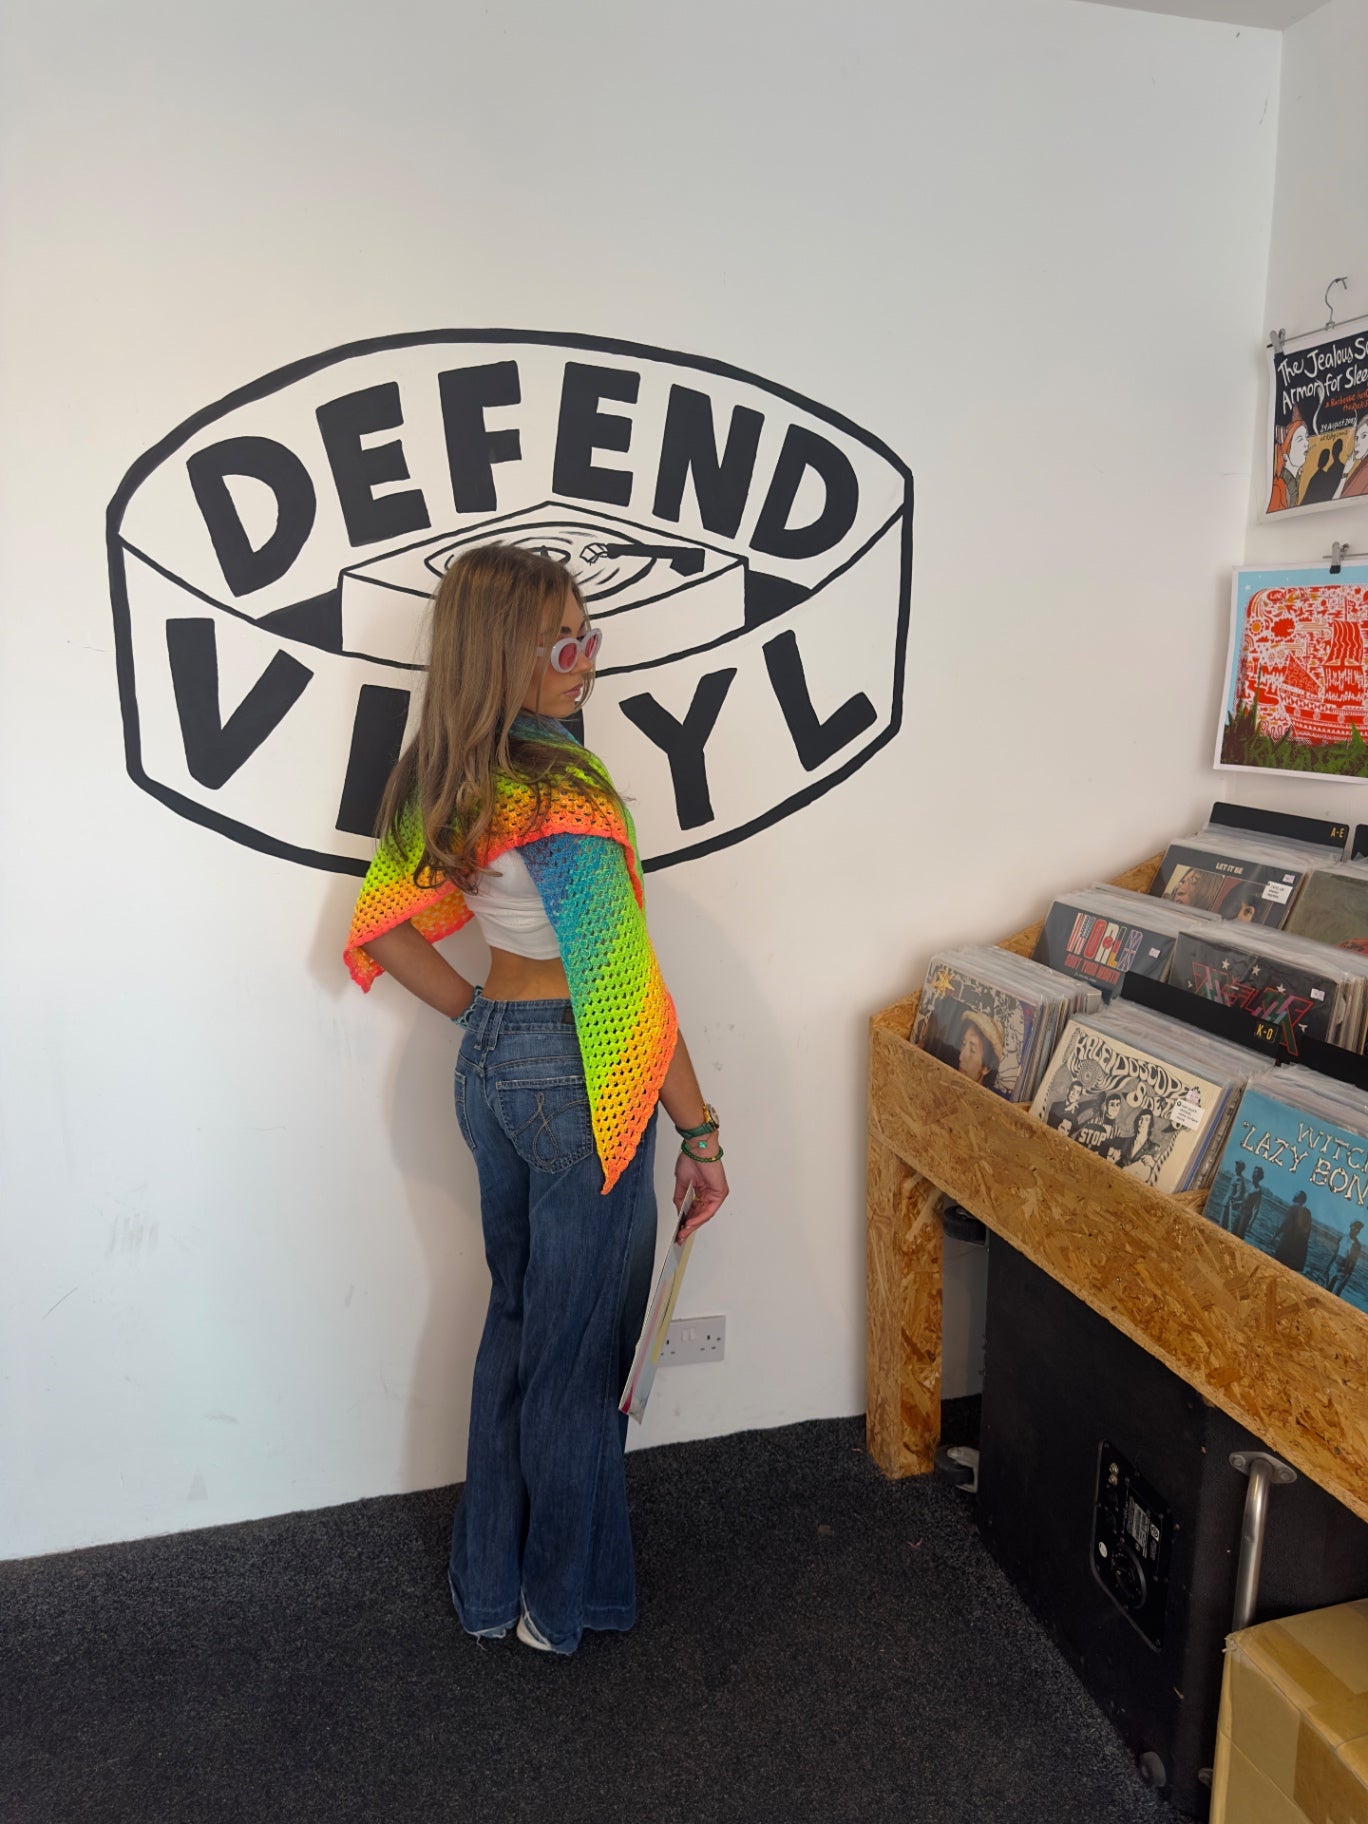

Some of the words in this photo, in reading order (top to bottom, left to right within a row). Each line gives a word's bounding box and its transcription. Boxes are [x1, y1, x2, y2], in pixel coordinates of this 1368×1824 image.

[1277, 358, 1305, 387] The
[1304, 343, 1354, 378] Jealous
[1282, 381, 1321, 415] Armor
[1324, 373, 1343, 397] for
[1344, 363, 1368, 389] Slee
[187, 361, 860, 597] DEFEND
[166, 618, 879, 832] VIYL
[1330, 826, 1345, 839] A-E
[1215, 861, 1228, 872] LET
[1227, 863, 1236, 873] IT
[1234, 865, 1245, 875] BE
[1256, 1023, 1274, 1041] K-O
[1078, 1127, 1107, 1147] STOP
[1298, 1122, 1368, 1174] WITC
